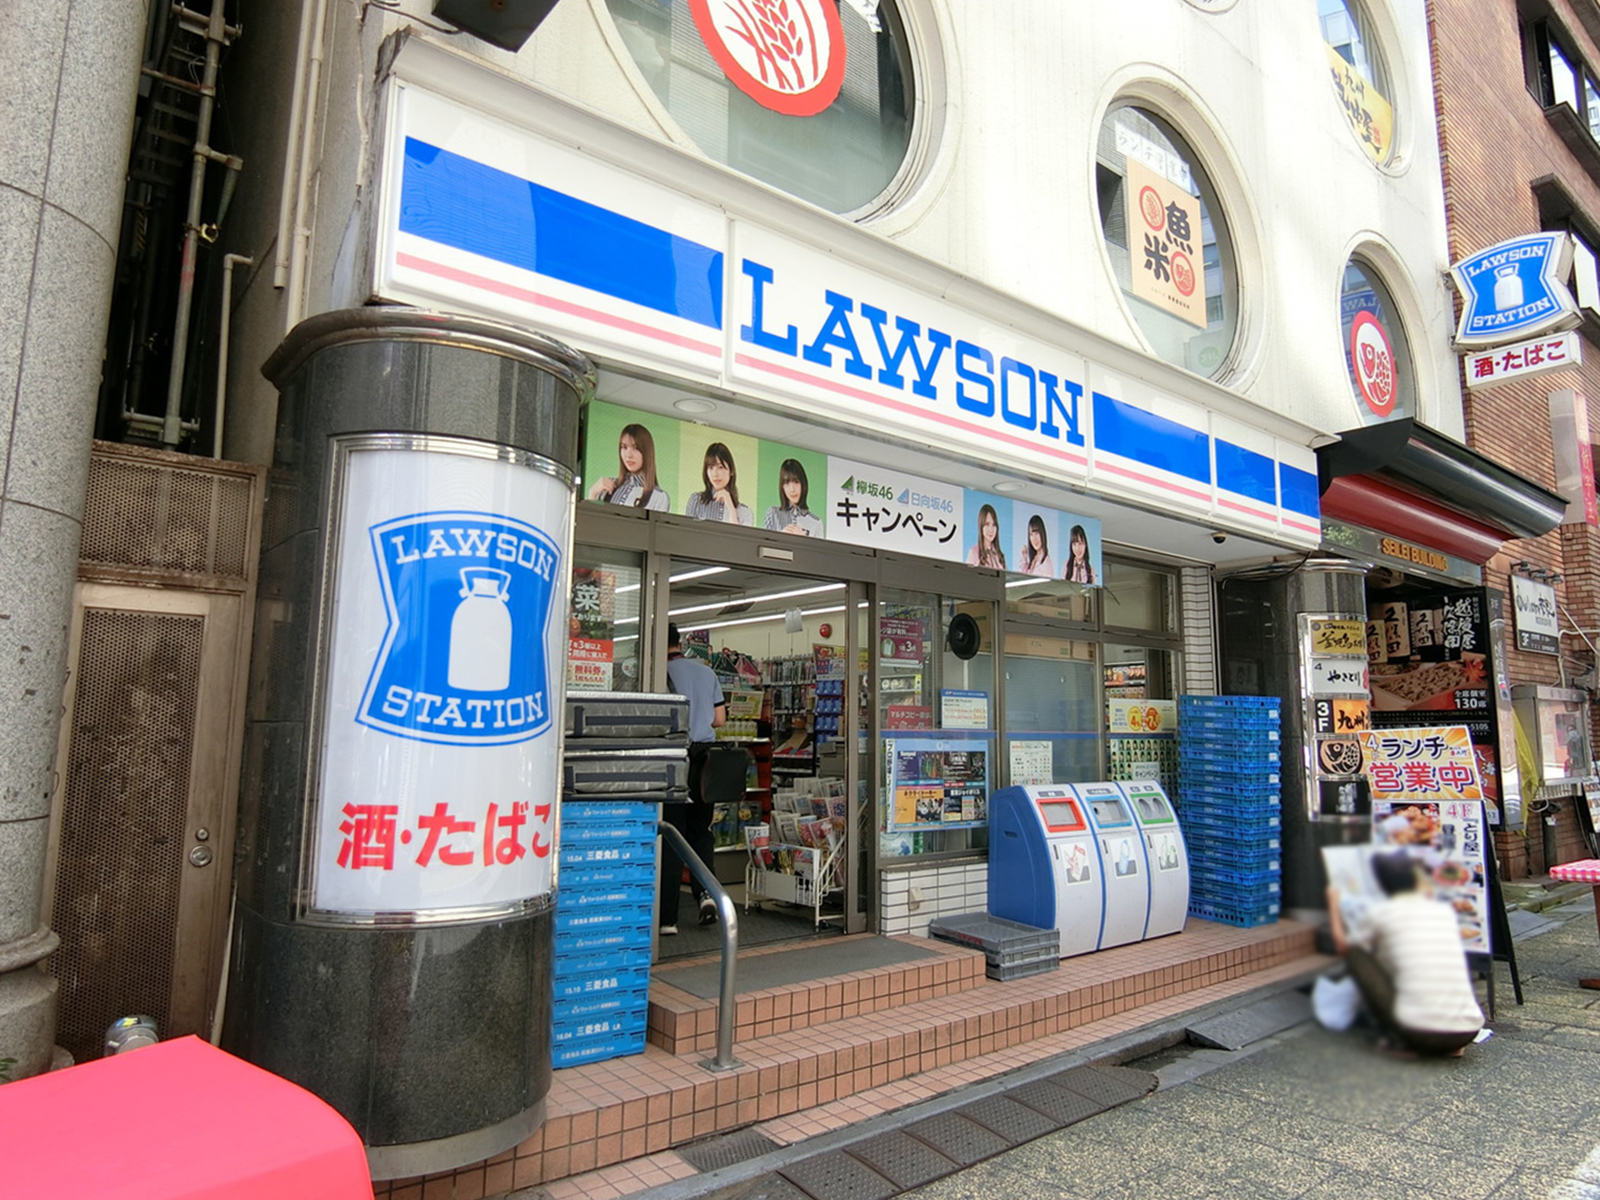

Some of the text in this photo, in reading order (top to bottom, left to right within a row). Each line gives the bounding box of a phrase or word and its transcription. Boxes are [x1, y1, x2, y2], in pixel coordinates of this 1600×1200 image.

[1165, 200, 1194, 256] 魚
[1144, 231, 1171, 284] 米
[1467, 245, 1546, 278] LAWSON
[1472, 296, 1552, 328] STATION
[740, 258, 1085, 448] LAWSON
[1474, 340, 1566, 378] 酒・たばこ
[856, 479, 954, 513] 欅坂46 日向坂46
[836, 497, 957, 543] キャンペーン
[390, 528, 554, 582] LAWSON
[381, 684, 544, 729] STATION
[1381, 736, 1446, 757] ランチ
[1369, 761, 1475, 792] 営業中
[336, 801, 551, 870] 酒・たばこ
[587, 849, 619, 861] 三菱食品
[585, 977, 618, 991] 三菱食品
[576, 1021, 610, 1036] 三菱食品
